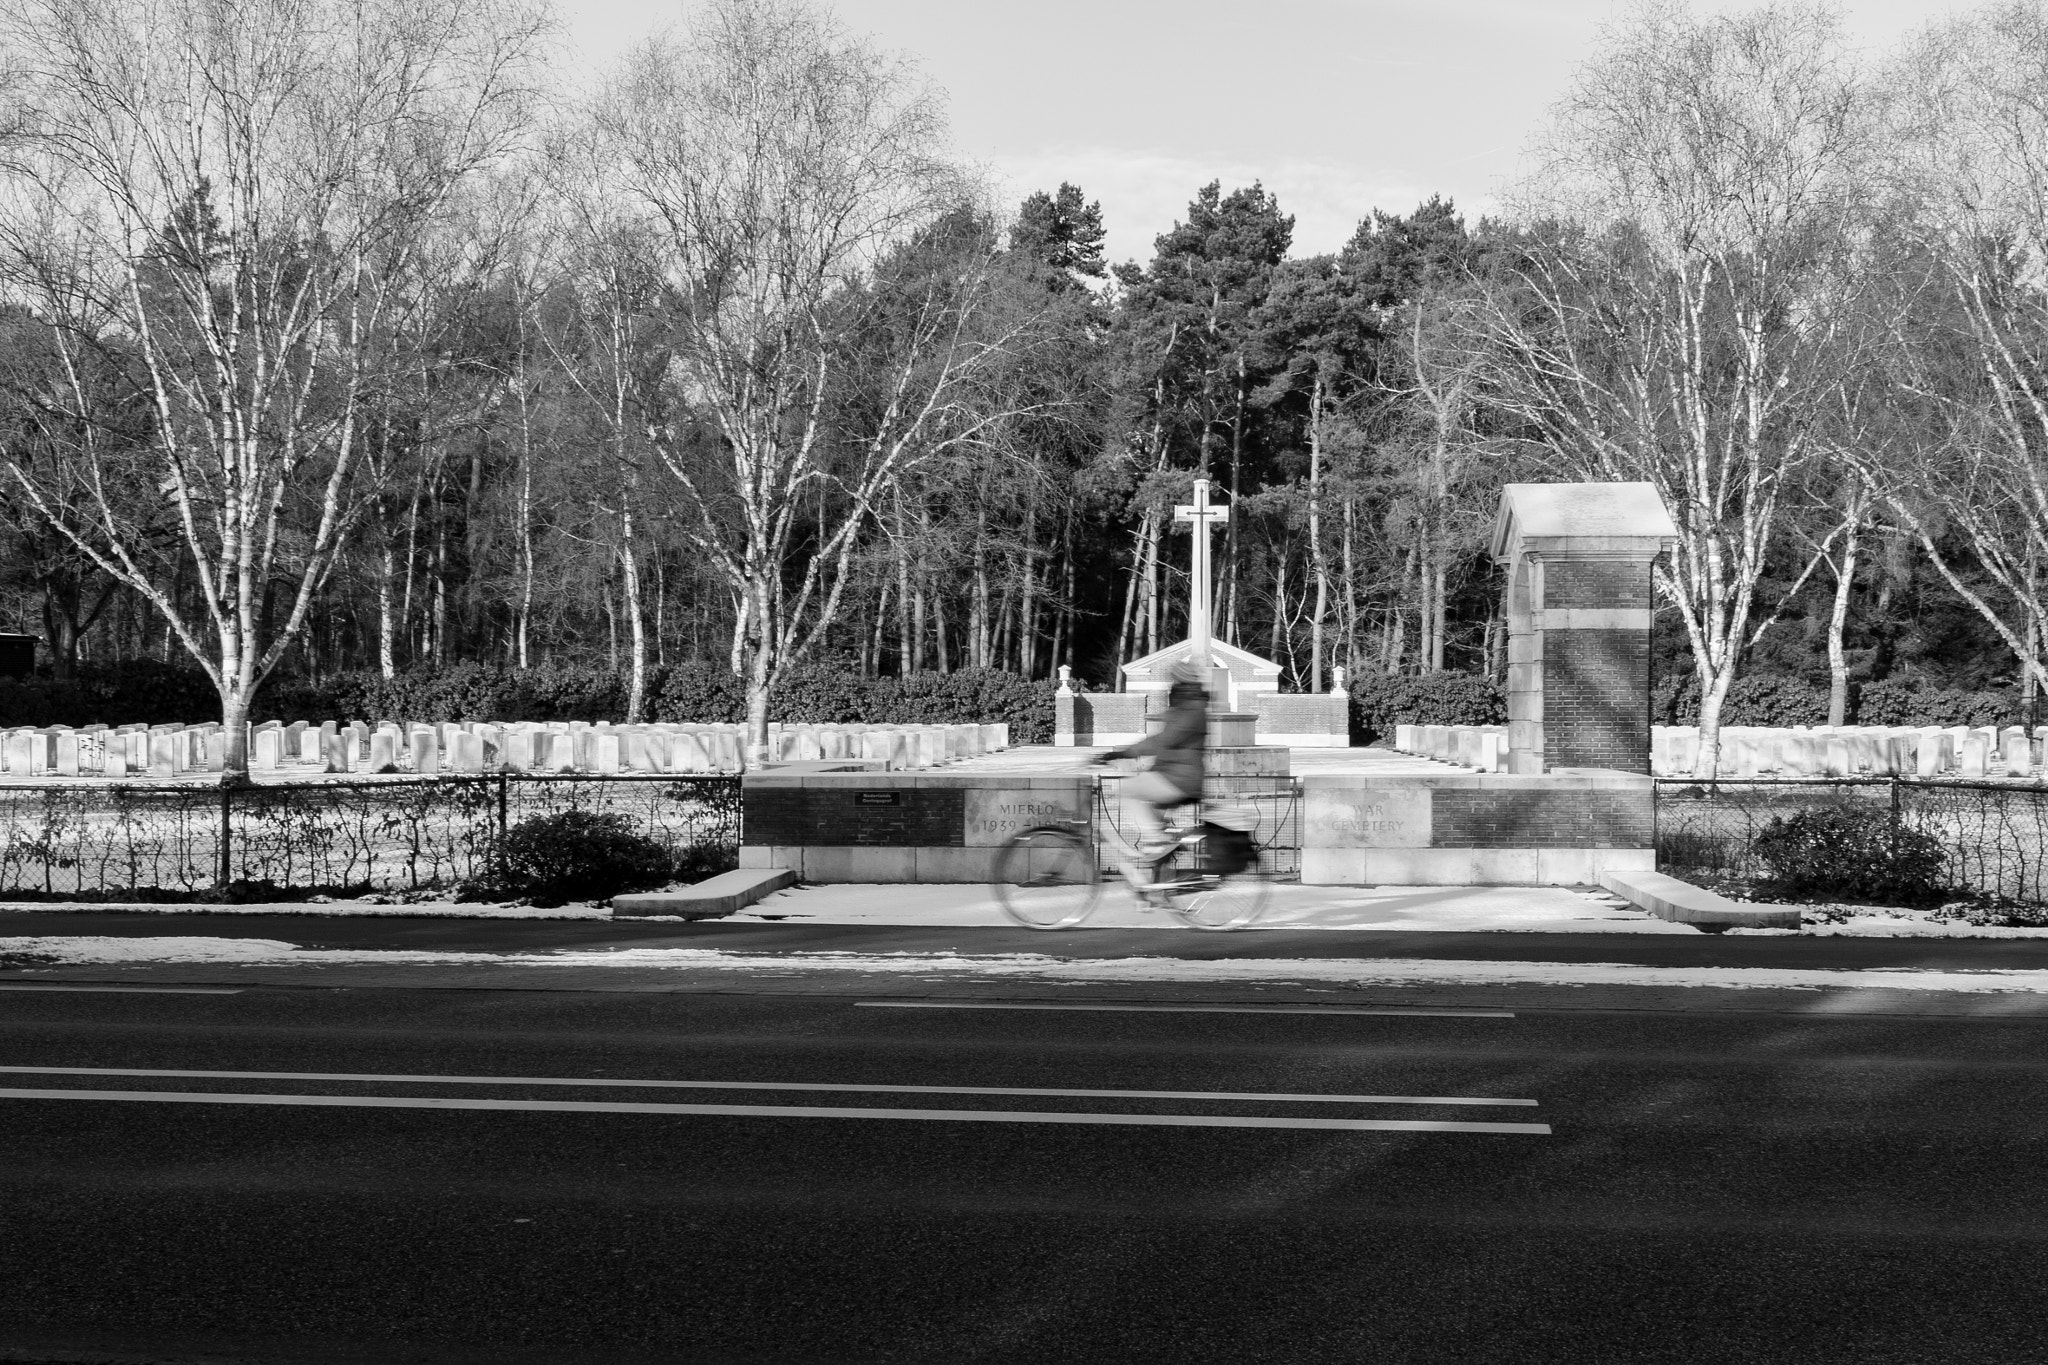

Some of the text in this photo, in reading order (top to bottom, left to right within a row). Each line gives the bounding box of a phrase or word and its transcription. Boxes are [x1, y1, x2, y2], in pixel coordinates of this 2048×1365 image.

[1000, 804, 1054, 815] MIERLO
[1352, 804, 1384, 816] WAR
[983, 820, 1016, 832] 1939
[1331, 820, 1405, 832] CEMETERY
